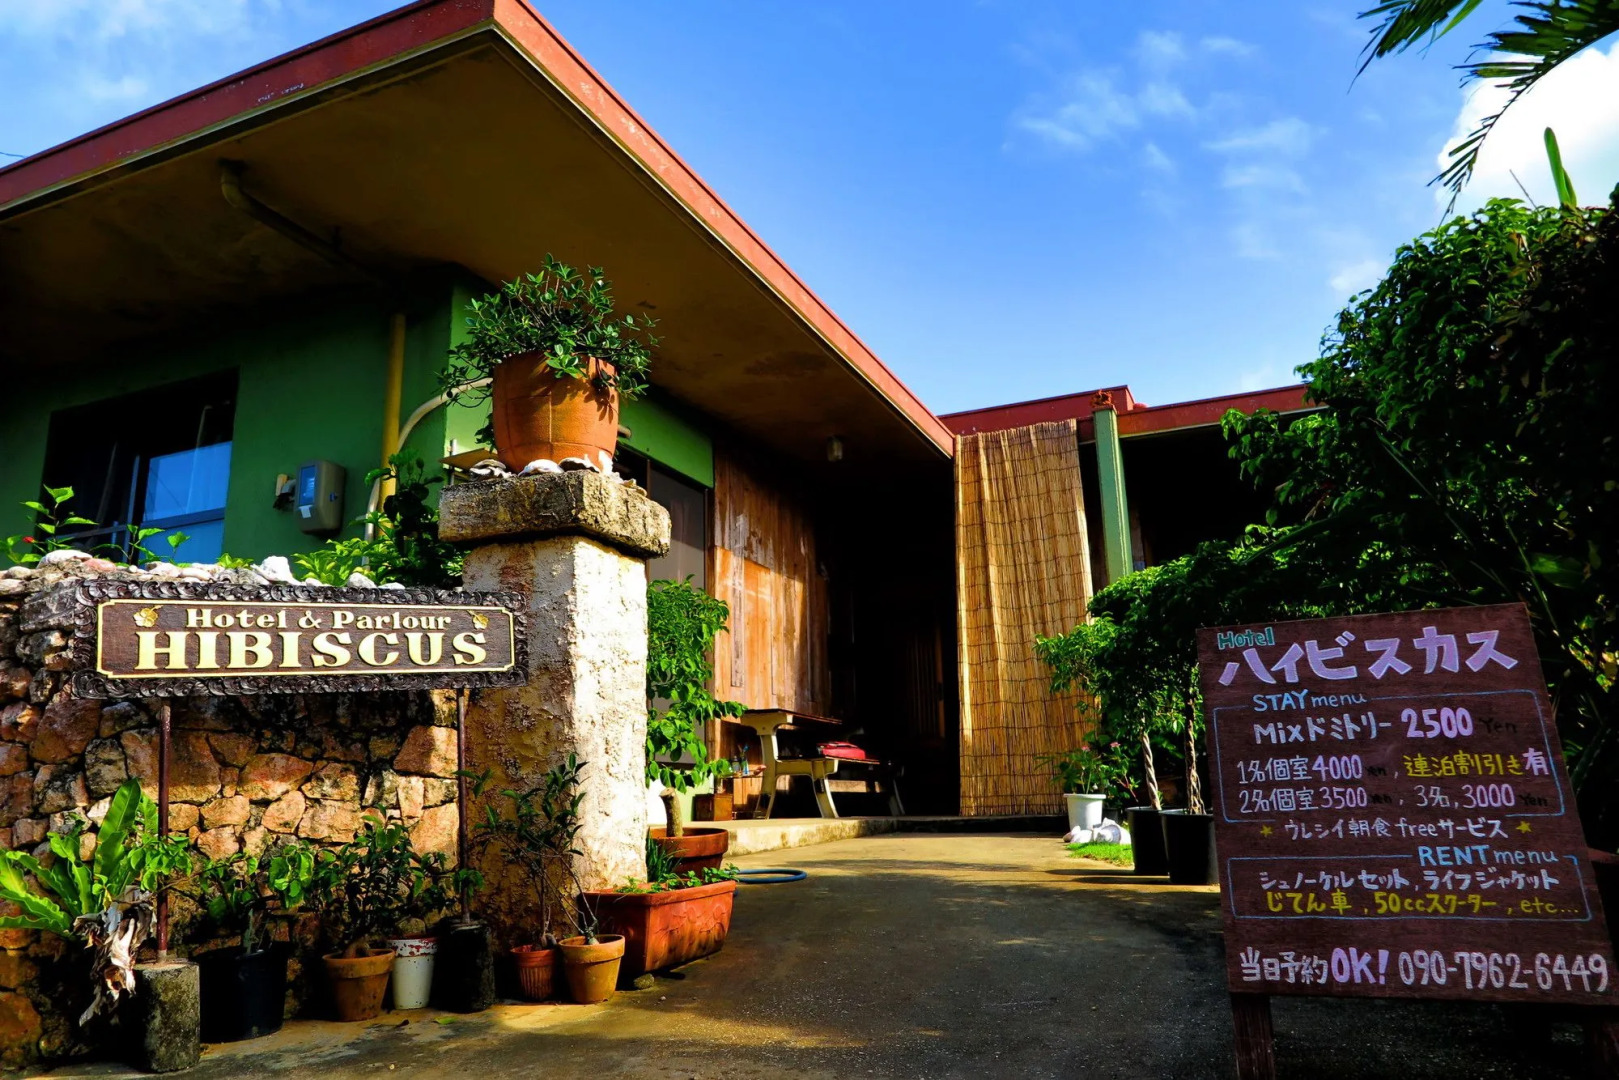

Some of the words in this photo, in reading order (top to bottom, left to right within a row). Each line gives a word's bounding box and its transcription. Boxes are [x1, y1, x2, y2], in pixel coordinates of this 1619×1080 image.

[186, 607, 288, 629] Hotel
[298, 610, 322, 629] &
[332, 610, 452, 631] Parlour
[134, 630, 488, 671] HIBISCUS
[1217, 626, 1275, 650] Hotel
[1218, 626, 1518, 687] ハイビスカス
[1252, 688, 1309, 712] STAY
[1311, 692, 1367, 708] menu
[1401, 707, 1474, 739] 2500
[1479, 717, 1518, 734] Yen
[1418, 844, 1490, 866] RENT
[1493, 850, 1559, 865] menu
[1398, 949, 1609, 992] 090-7962-6449
